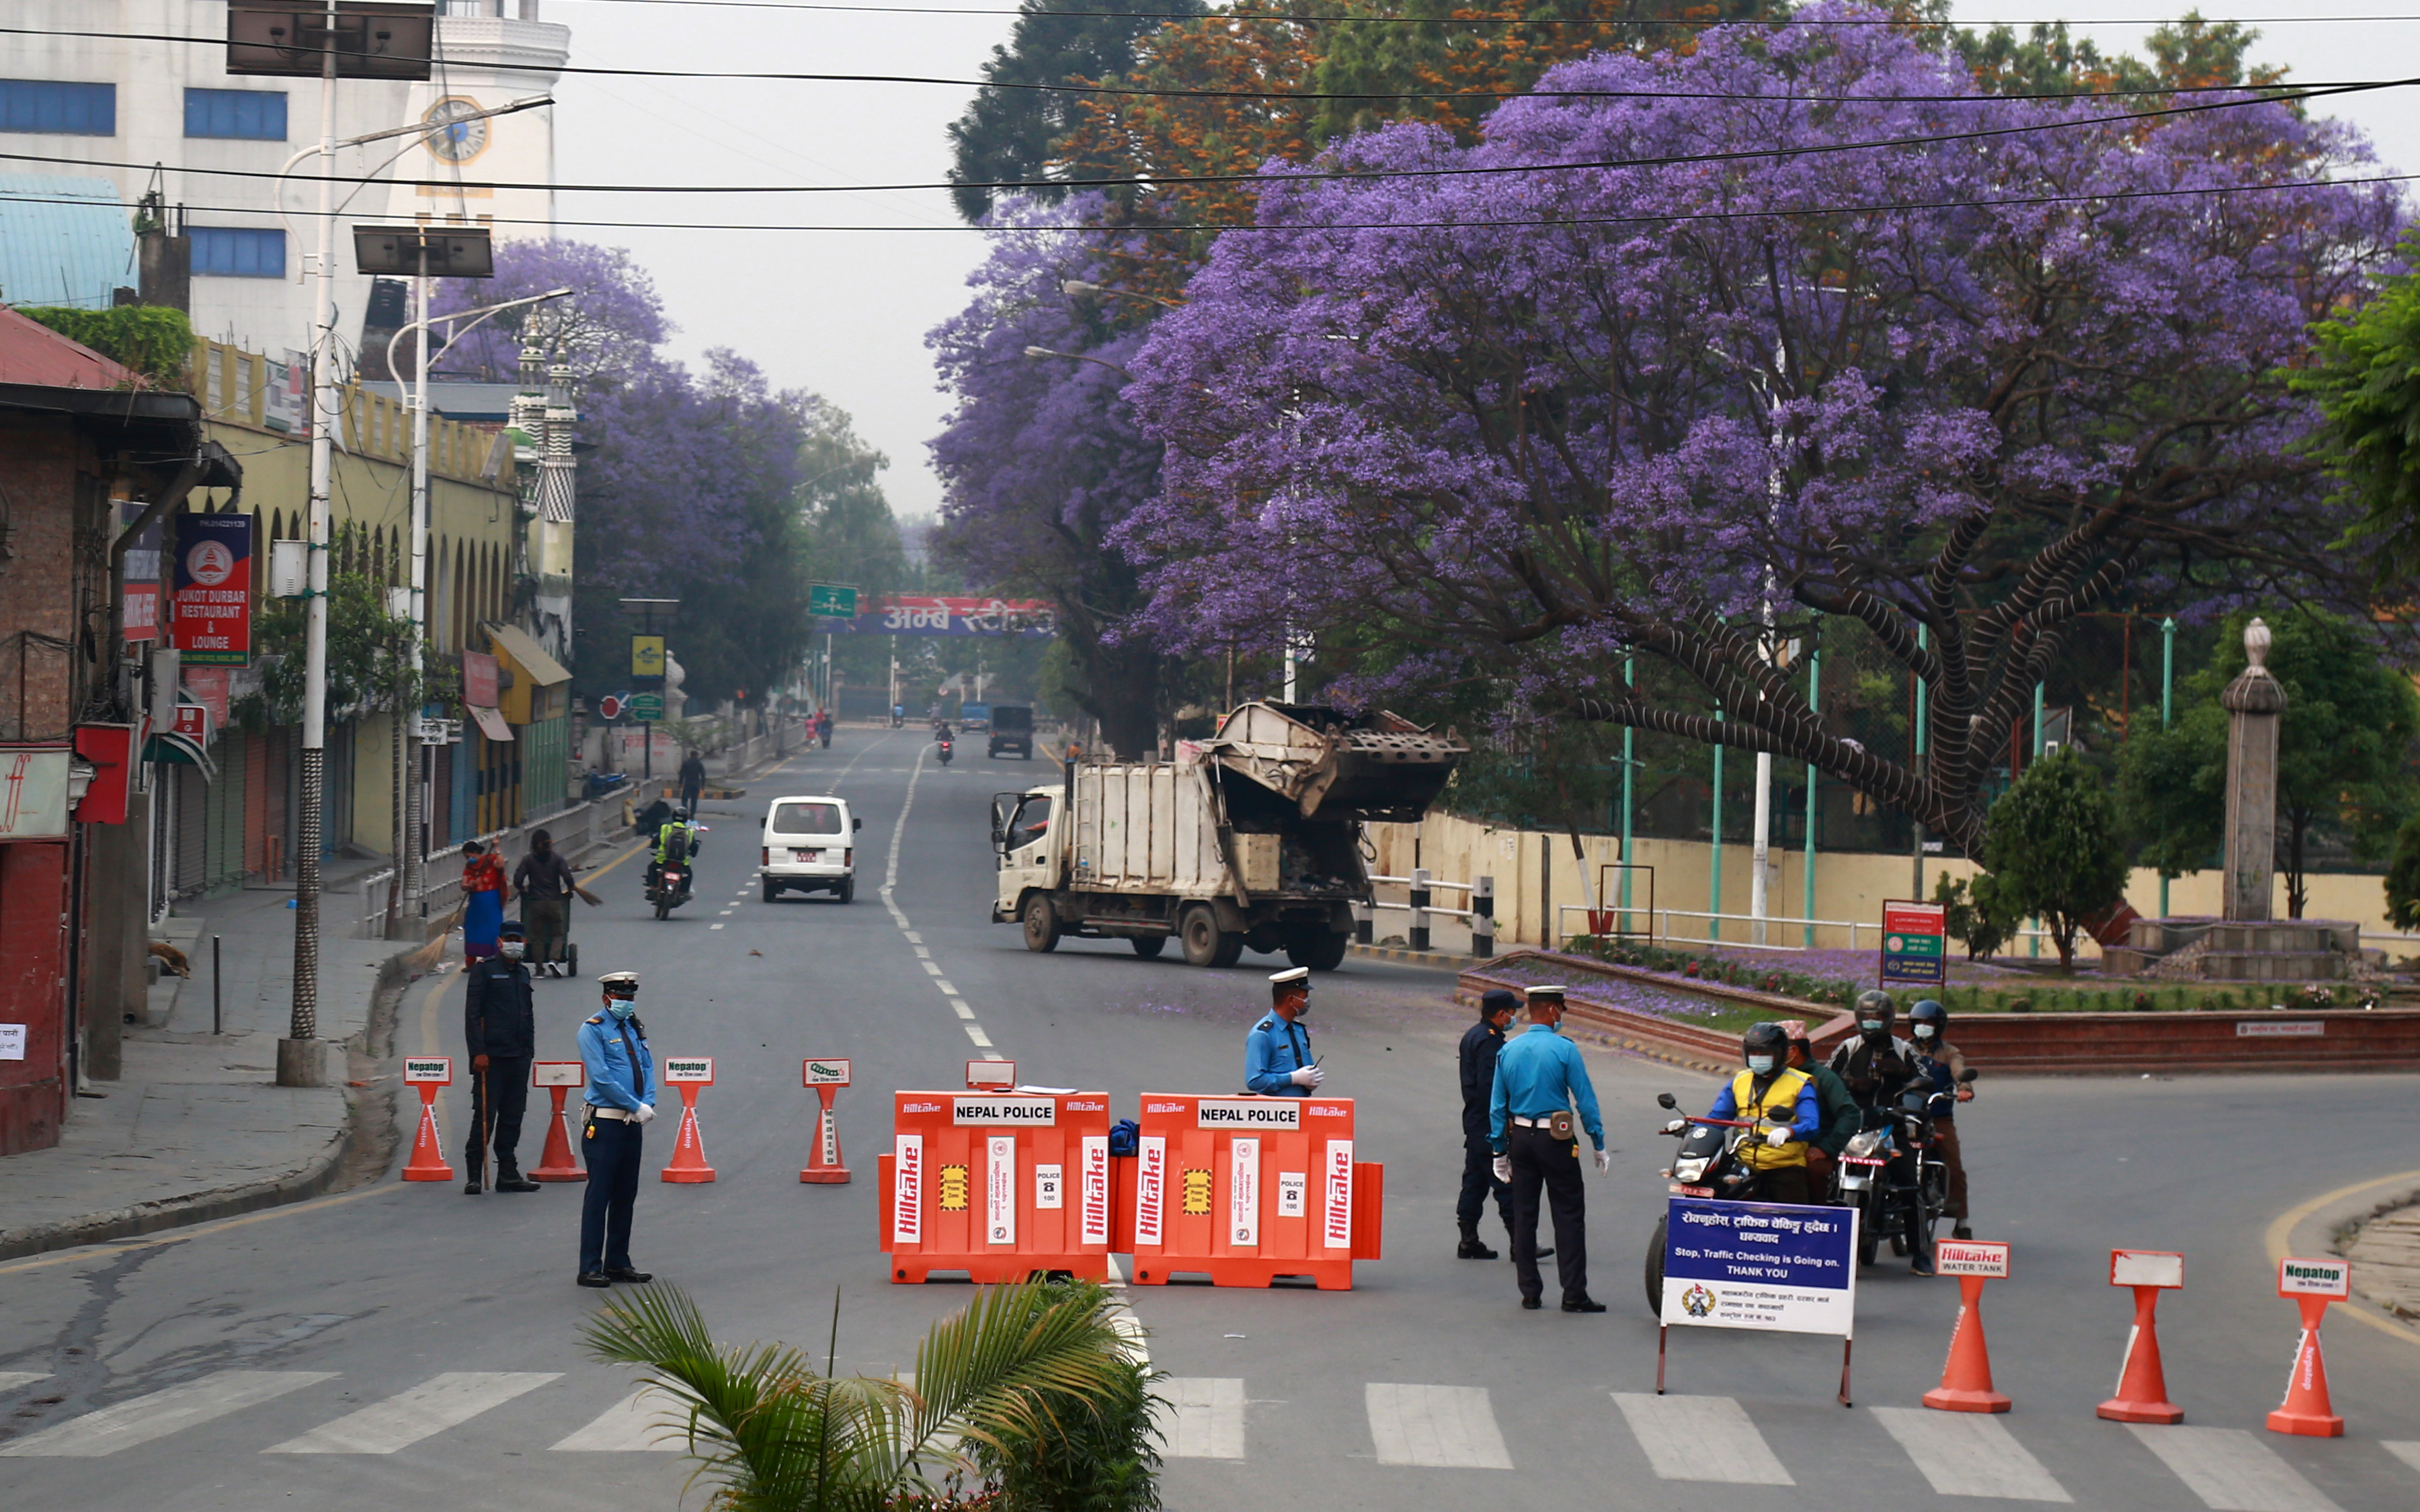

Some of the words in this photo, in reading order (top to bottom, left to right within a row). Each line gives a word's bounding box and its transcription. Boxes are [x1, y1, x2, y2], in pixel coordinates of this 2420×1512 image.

[177, 589, 207, 602] JUKOT
[209, 590, 245, 603] DURBAR
[182, 605, 241, 618] RESTAURANT
[883, 599, 953, 630] अम्बे
[207, 621, 214, 633] &
[192, 636, 229, 649] LOUNGE
[408, 1062, 444, 1072] Nepatop
[668, 1062, 707, 1072] Nepatop
[903, 1102, 941, 1114] Hilltake
[956, 1107, 999, 1119] NEPAL
[1004, 1106, 1052, 1119] POLICE
[1066, 1101, 1104, 1112] Hilltake
[1147, 1103, 1185, 1114] Hilltake
[1309, 1106, 1347, 1118] Hilltake
[1201, 1109, 1244, 1122] NEPAL
[1248, 1109, 1297, 1123] POLICE
[419, 1117, 429, 1148] Nepatop
[683, 1118, 692, 1148] Nepatop
[898, 1146, 918, 1234] Hilltake
[1086, 1148, 1104, 1236] Hilltake
[1140, 1148, 1161, 1236] Hilltake
[1328, 1152, 1348, 1240] Hilltake
[1733, 1214, 1769, 1228] ट्राफिक
[1739, 1231, 1780, 1244] धन्यवाद
[1675, 1247, 1701, 1259] Stop,
[1703, 1248, 1734, 1260] Traffic
[1736, 1251, 1781, 1265] Checking
[1782, 1255, 1791, 1263] is
[1793, 1255, 1822, 1268] Going
[1824, 1259, 1840, 1267] on.
[1941, 1248, 2003, 1263] Hilltake
[1726, 1265, 1763, 1277] THANK
[1765, 1268, 1789, 1279] YOU
[1943, 1263, 1975, 1271] WATER
[1978, 1264, 2003, 1273] TANK
[2286, 1264, 2340, 1281] Nepatop
[2301, 1346, 2316, 1391] Nepatop
